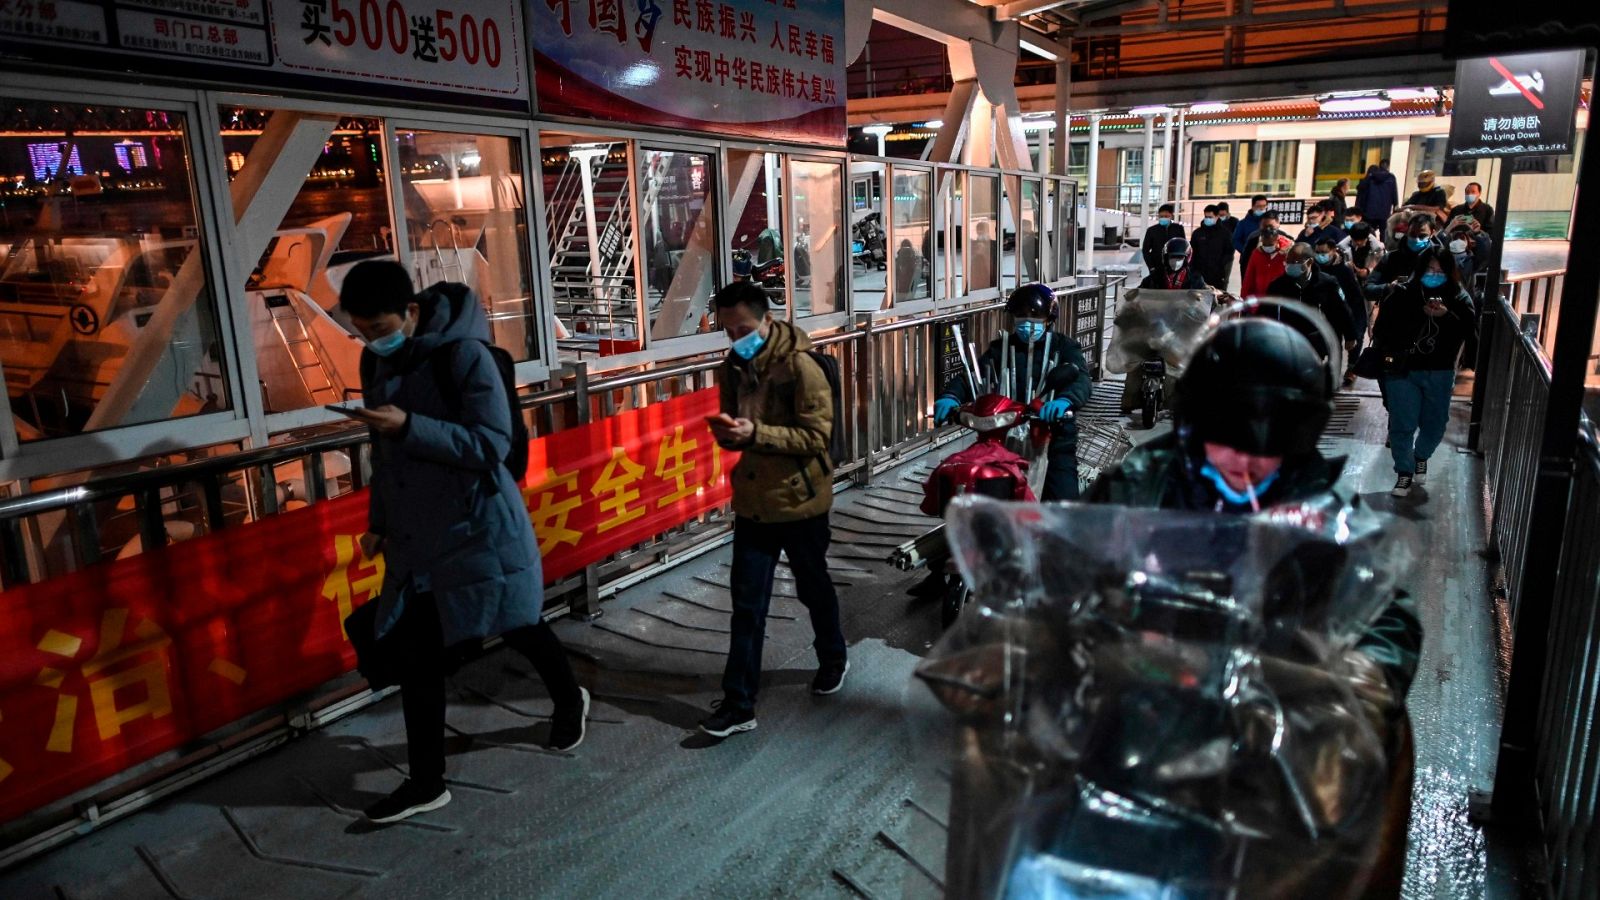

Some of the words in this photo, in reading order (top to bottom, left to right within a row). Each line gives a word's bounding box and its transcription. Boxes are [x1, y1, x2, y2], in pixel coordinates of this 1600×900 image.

[154, 18, 238, 45] 司门口总部
[674, 0, 757, 43] 民族振兴
[770, 21, 835, 64] 人民幸福
[675, 45, 836, 105] 实现中华民族伟大复兴
[1483, 116, 1541, 132] 请勿躺卧
[1494, 133, 1516, 142] Lying
[1517, 131, 1540, 139] Down
